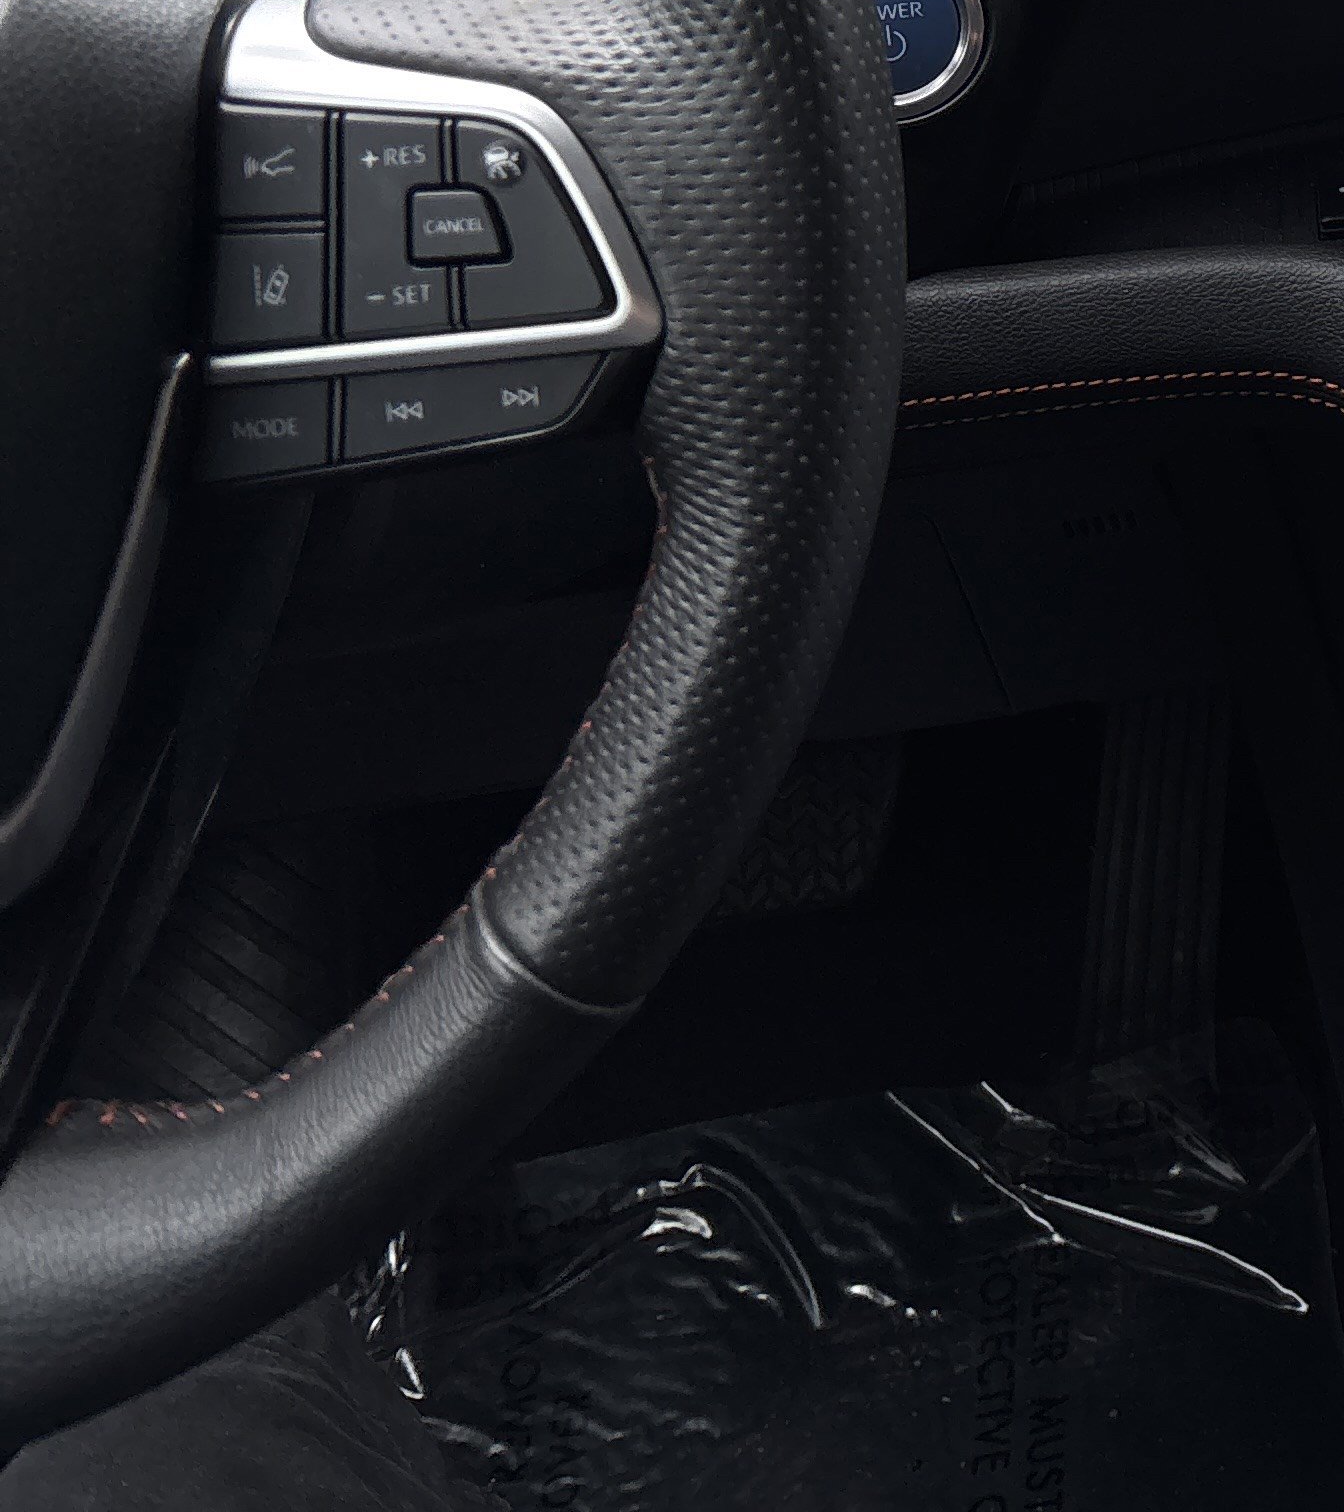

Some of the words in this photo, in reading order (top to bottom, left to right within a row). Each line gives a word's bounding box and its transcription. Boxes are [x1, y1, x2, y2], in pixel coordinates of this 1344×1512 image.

[876, 1, 924, 21] WER
[423, 216, 484, 236] CANCEL
[231, 417, 299, 440] MODE
